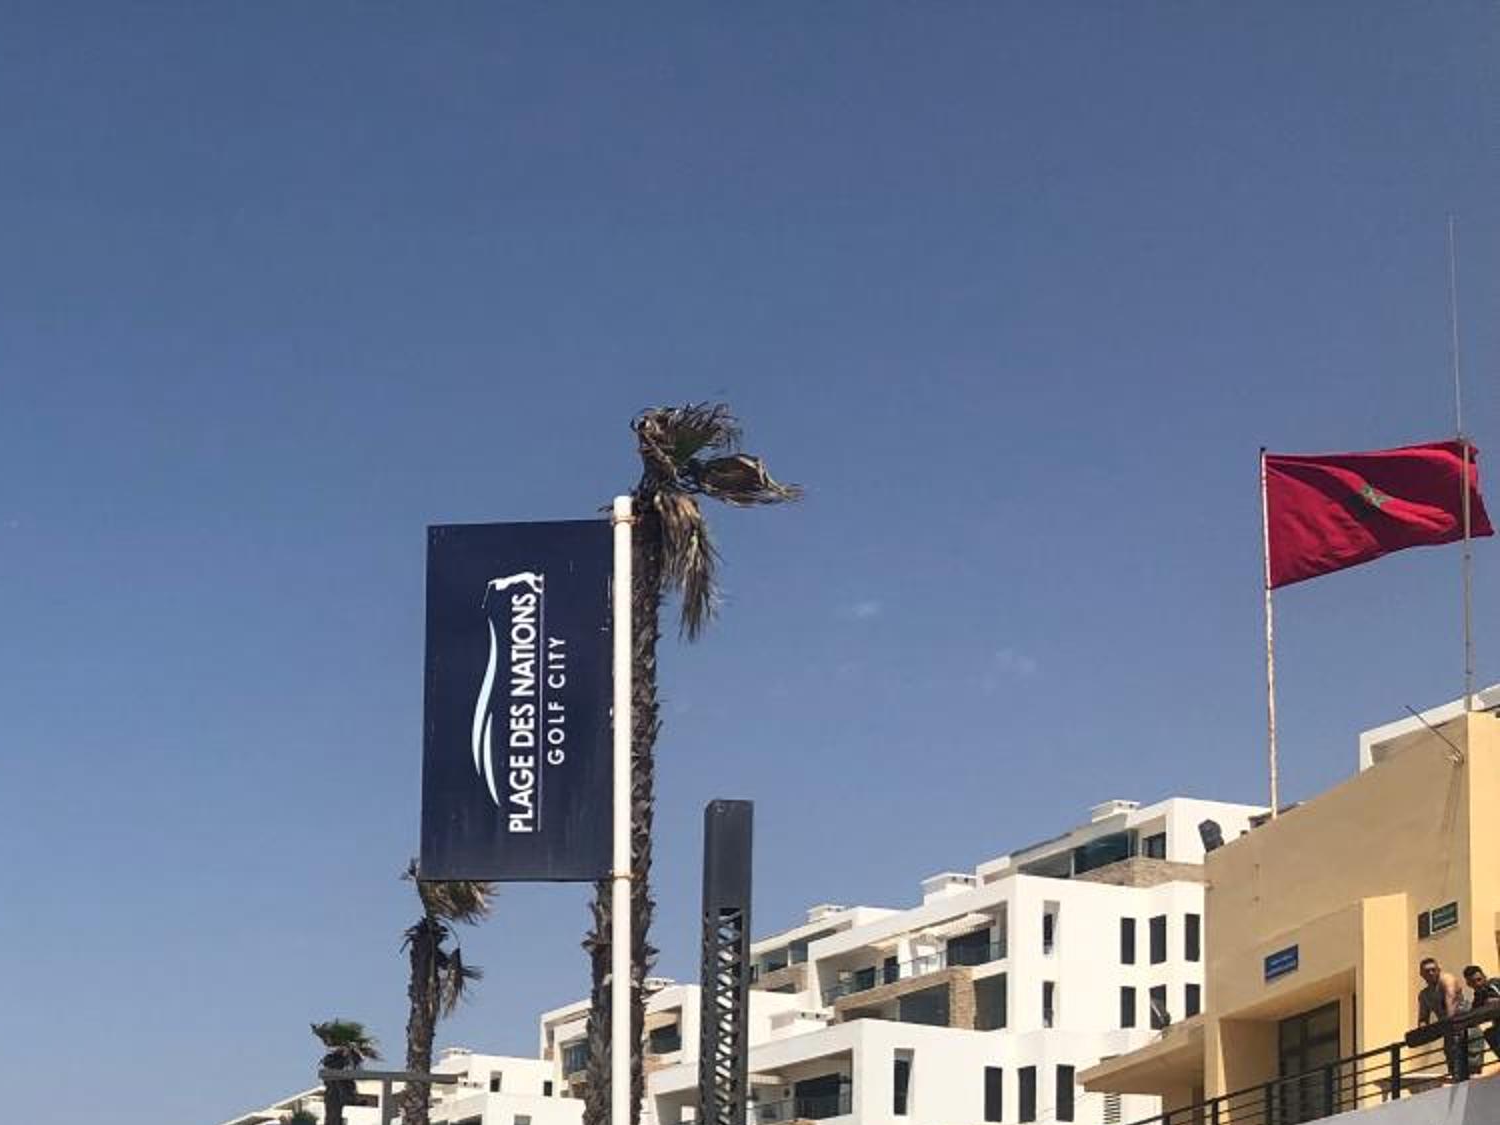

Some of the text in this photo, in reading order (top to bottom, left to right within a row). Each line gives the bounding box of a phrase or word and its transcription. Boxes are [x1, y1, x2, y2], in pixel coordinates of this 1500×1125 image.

[509, 593, 536, 832] PLAGE DES NATIONS
[547, 637, 566, 765] GOLF CITY
